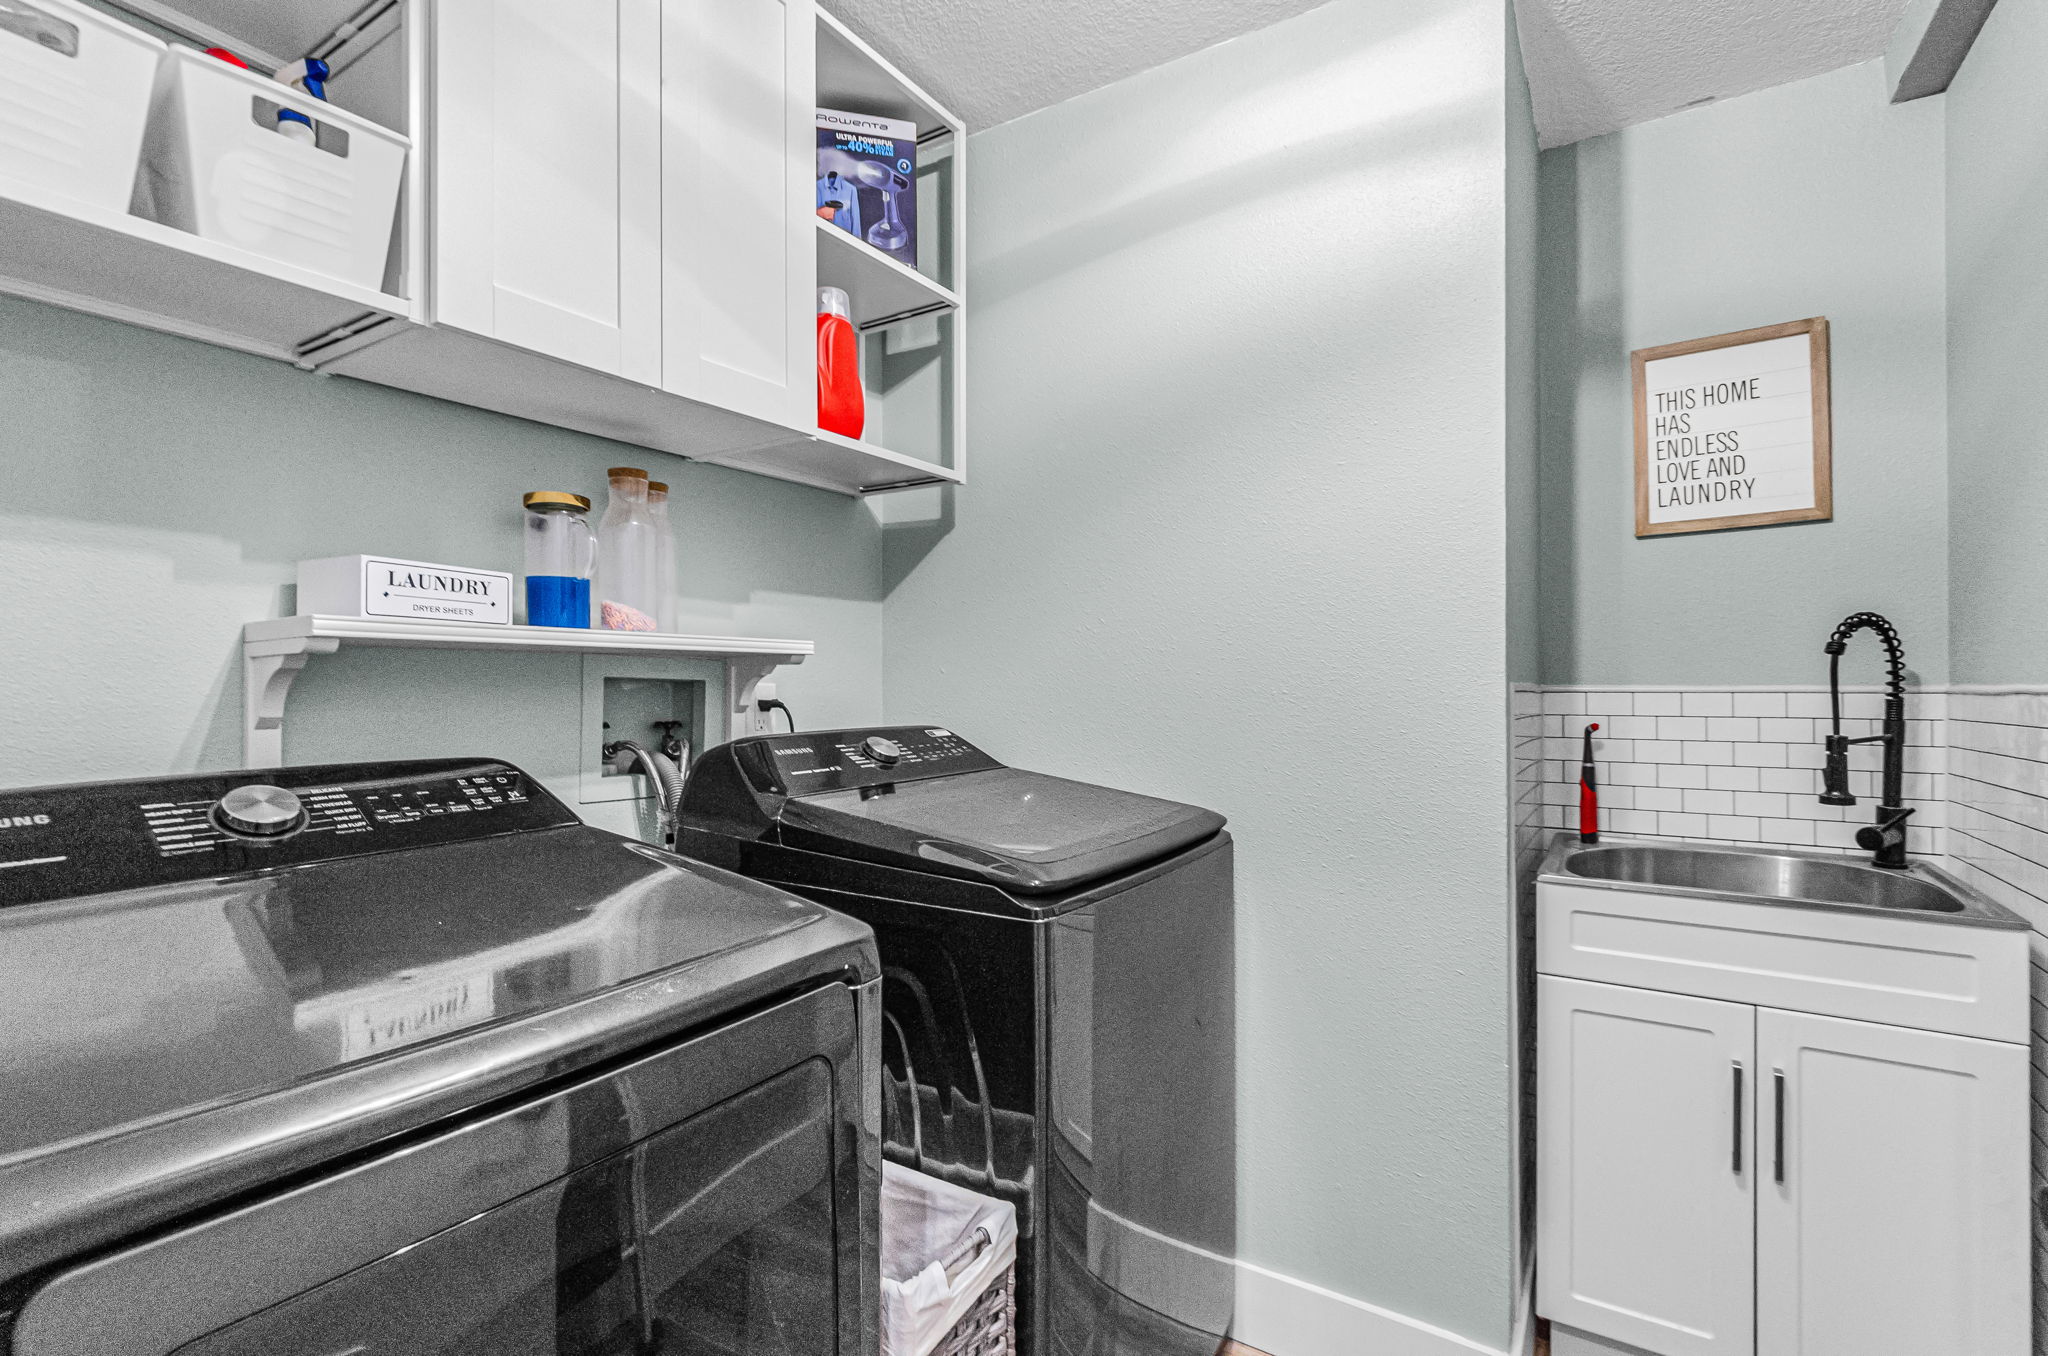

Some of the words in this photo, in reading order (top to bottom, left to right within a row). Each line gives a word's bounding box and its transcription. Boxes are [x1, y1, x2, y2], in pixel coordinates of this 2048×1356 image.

[835, 132, 857, 142] ULTRA
[847, 141, 875, 154] 40%
[1655, 388, 1696, 413] THIS
[1703, 378, 1761, 406] HOME
[1655, 412, 1691, 437] HAS
[1656, 430, 1739, 461] ENDLESS
[1657, 459, 1701, 484] LOVE
[1706, 454, 1746, 478] AND
[1657, 477, 1756, 508] LAUNDRY
[387, 570, 491, 596] LAUNDRY
[412, 604, 441, 614] DRYER
[442, 605, 474, 616] SHEETS
